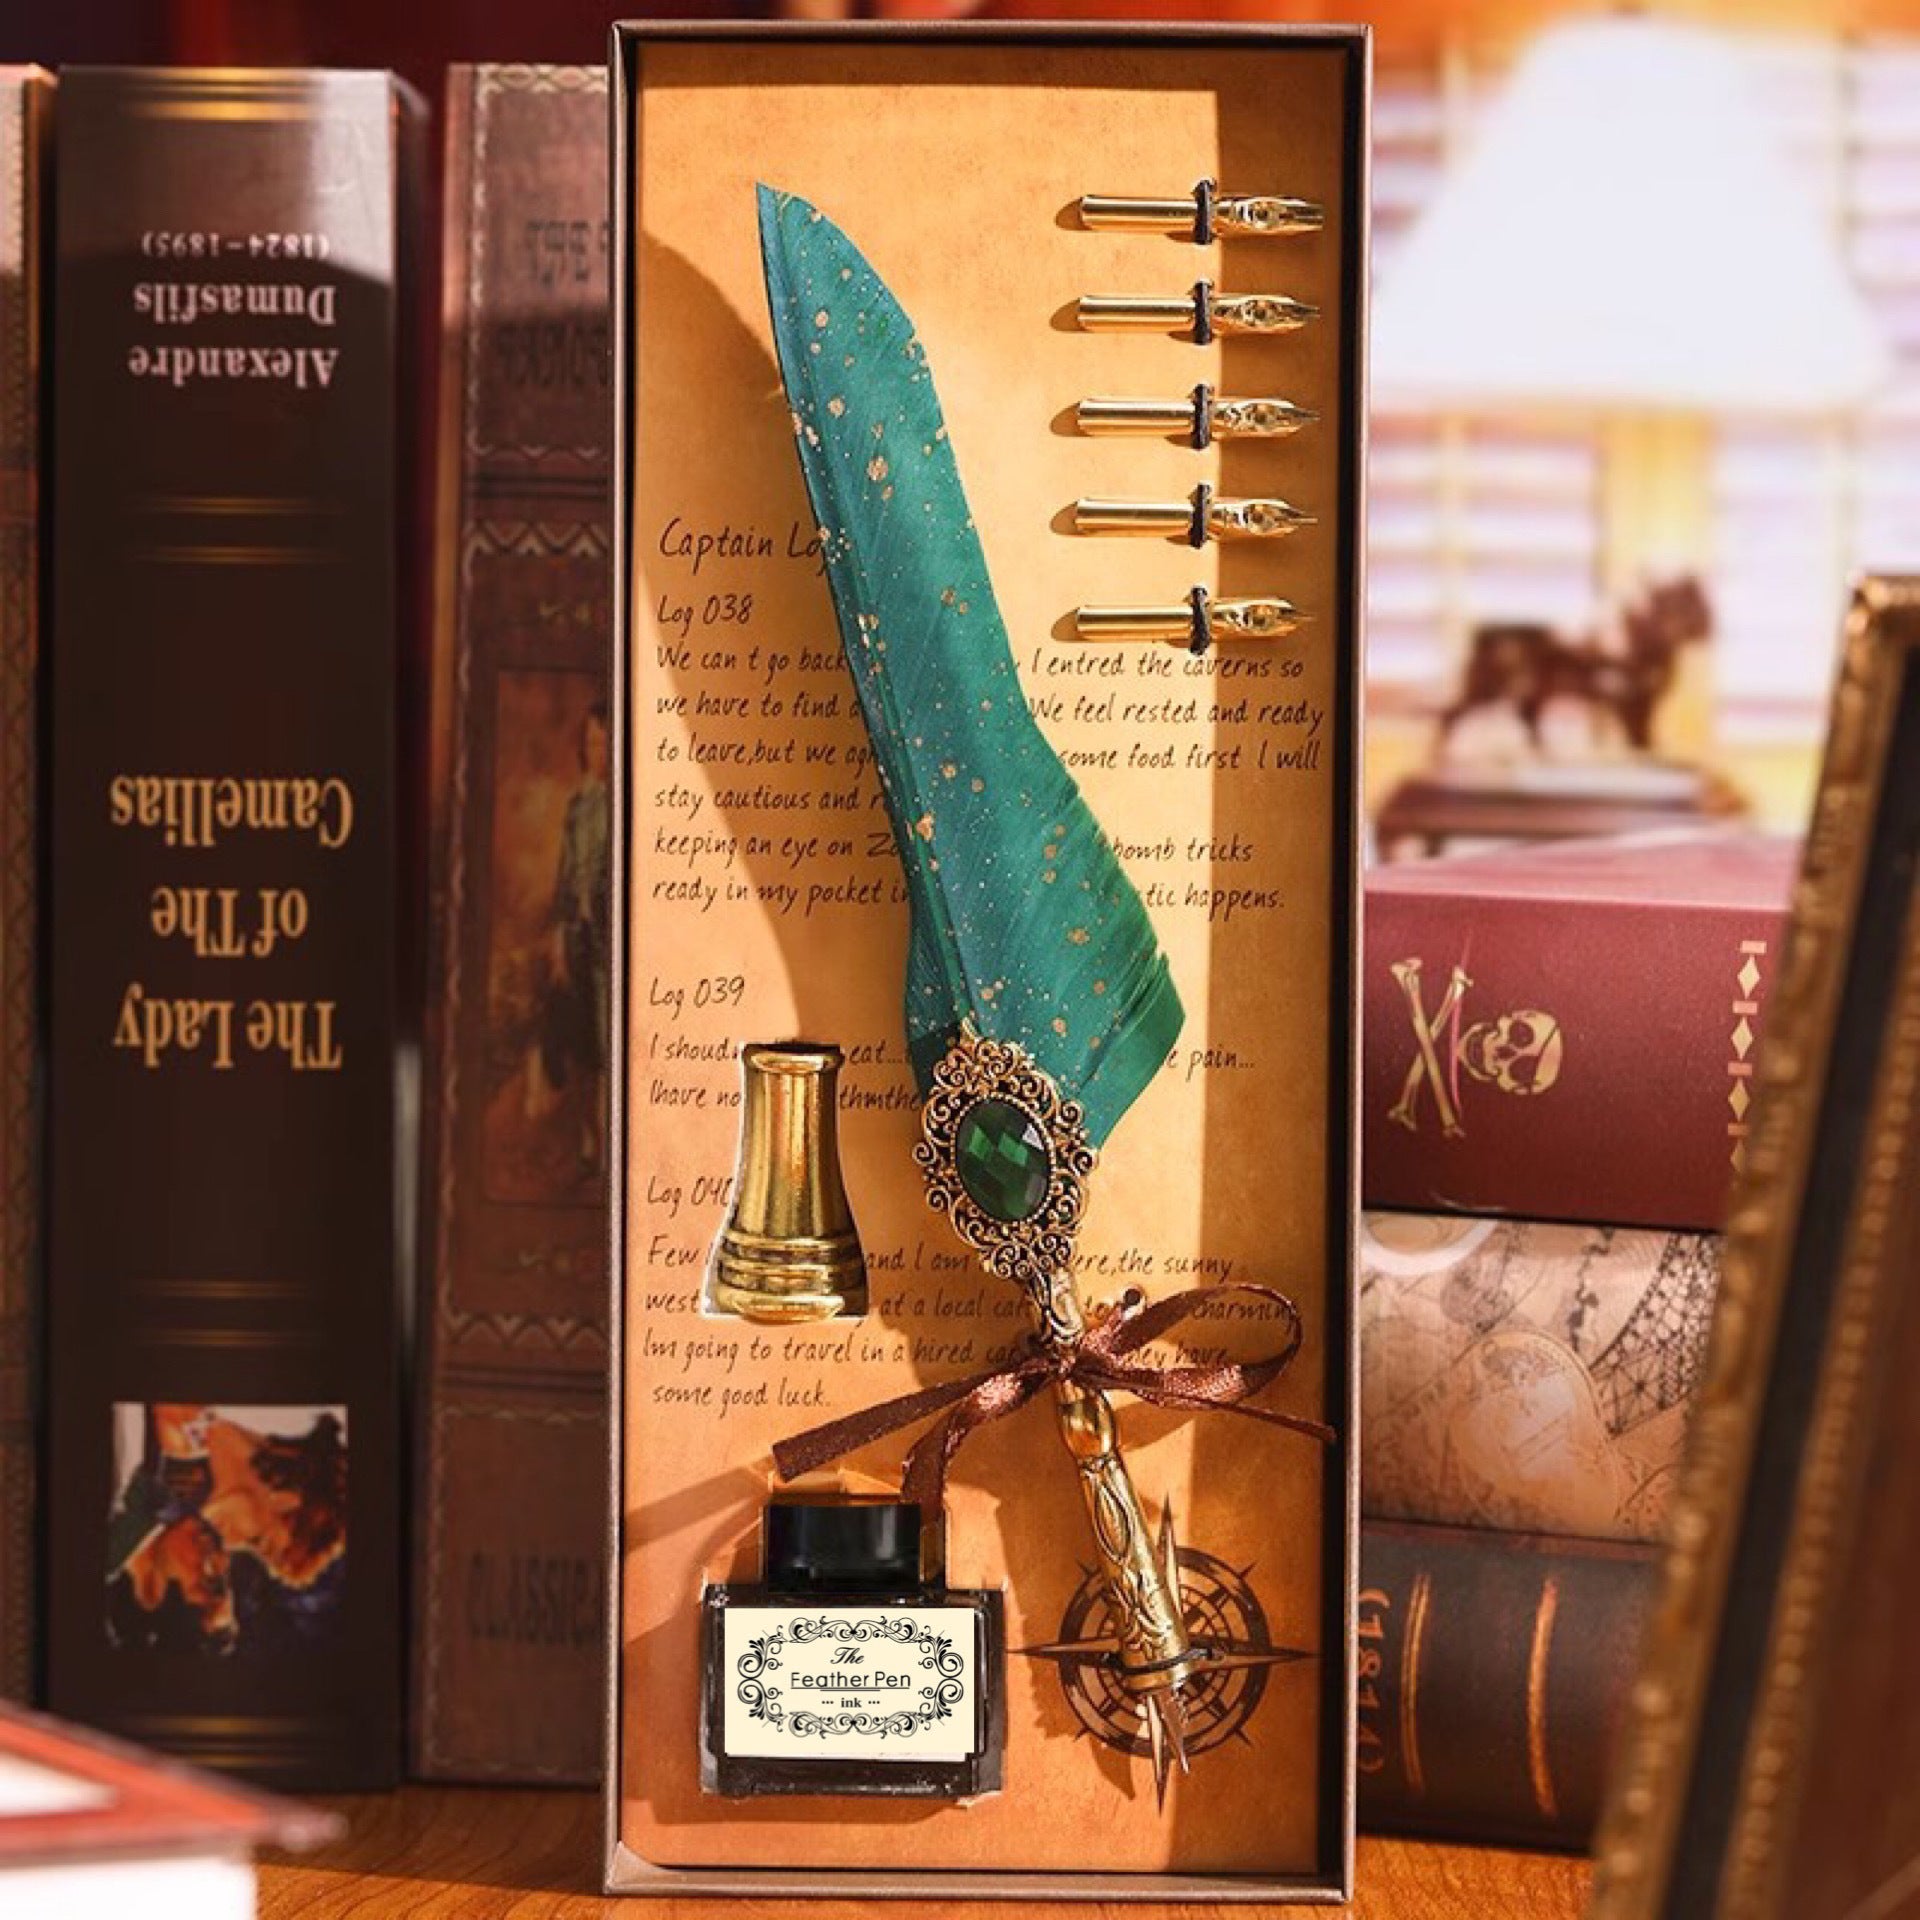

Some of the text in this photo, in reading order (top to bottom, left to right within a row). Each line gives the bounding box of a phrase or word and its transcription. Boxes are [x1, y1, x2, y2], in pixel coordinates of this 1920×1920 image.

[133, 283, 336, 325] Dumasfils
[128, 346, 339, 388] Alexandre
[659, 517, 774, 575] Captain
[657, 593, 753, 636] Log 038
[657, 641, 691, 669] We
[767, 650, 790, 685] go
[1047, 650, 1125, 677] entred
[1137, 650, 1173, 677] the
[1183, 654, 1271, 678] caverns
[1281, 660, 1304, 678] so
[657, 694, 686, 716] we
[696, 690, 750, 717] have
[761, 694, 782, 717] to
[792, 690, 840, 718] find
[1028, 691, 1325, 737] We feel rested and ready
[657, 741, 679, 763] to
[806, 743, 837, 764] we
[1127, 742, 1175, 770] food
[1185, 743, 1242, 770] first
[1276, 739, 1321, 771] will
[110, 775, 354, 848] Camellias
[654, 786, 704, 821] stay
[714, 787, 810, 811] cautious
[818, 787, 860, 811] and
[654, 827, 738, 870] keeping
[746, 835, 773, 859] an
[781, 835, 823, 870] eye
[827, 837, 853, 859] on
[1187, 833, 1255, 864] tricks
[652, 875, 718, 914] ready
[727, 880, 748, 902] in
[758, 883, 799, 916] my
[807, 874, 884, 918] pocket
[151, 886, 308, 957] of The
[649, 975, 746, 1020] Log 039
[113, 981, 344, 1069] The Lady
[648, 1175, 683, 1218] Log
[648, 1234, 698, 1268] Few
[1162, 1255, 1234, 1284] sunny
[645, 1288, 700, 1311] west
[935, 1286, 985, 1317] local
[685, 1334, 740, 1372] going
[750, 1336, 771, 1359] to
[784, 1328, 854, 1363] travel
[861, 1338, 884, 1361] in
[892, 1344, 904, 1361] a
[914, 1337, 974, 1364] hired
[652, 1376, 832, 1419] some good luck.
[830, 1646, 865, 1665] The
[791, 1671, 911, 1688] Feather Pen
[841, 1697, 862, 1709] ink
